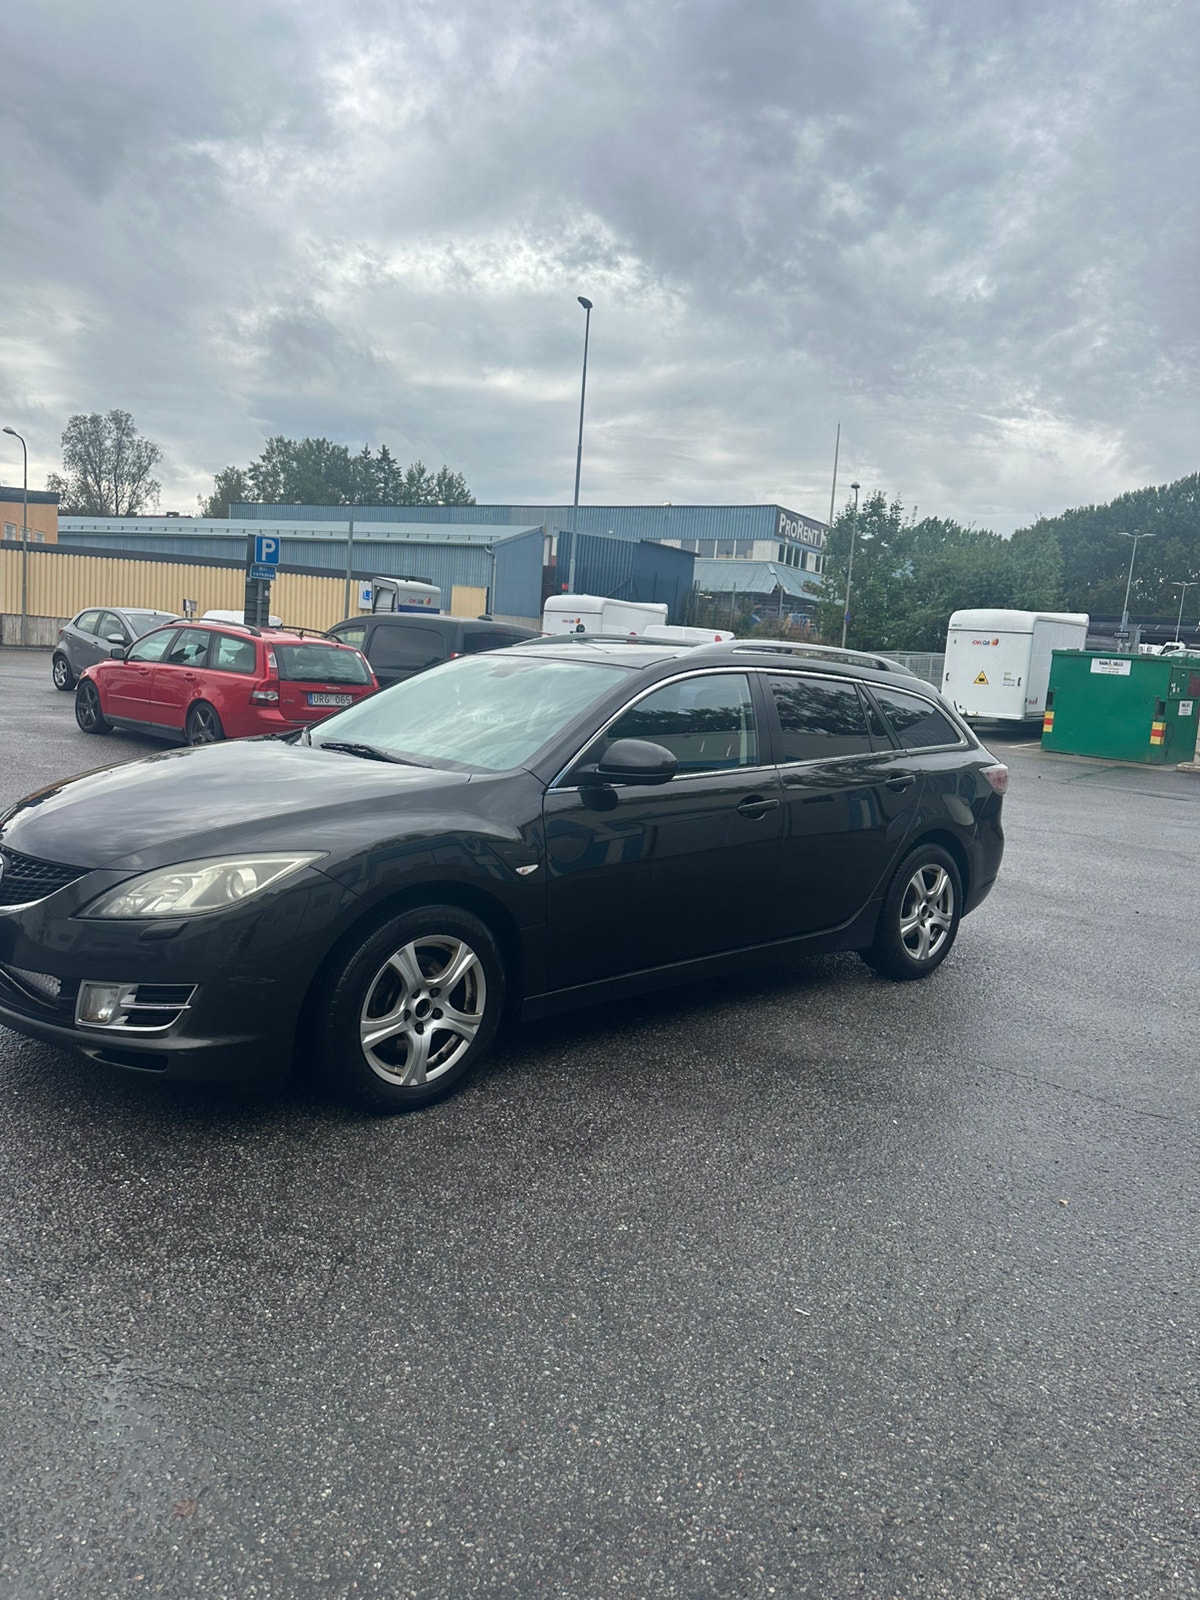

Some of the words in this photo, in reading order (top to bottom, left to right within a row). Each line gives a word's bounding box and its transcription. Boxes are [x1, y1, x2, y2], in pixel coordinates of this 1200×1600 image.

[261, 538, 276, 561] P
[313, 694, 330, 704] URG
[335, 695, 351, 704] 065
